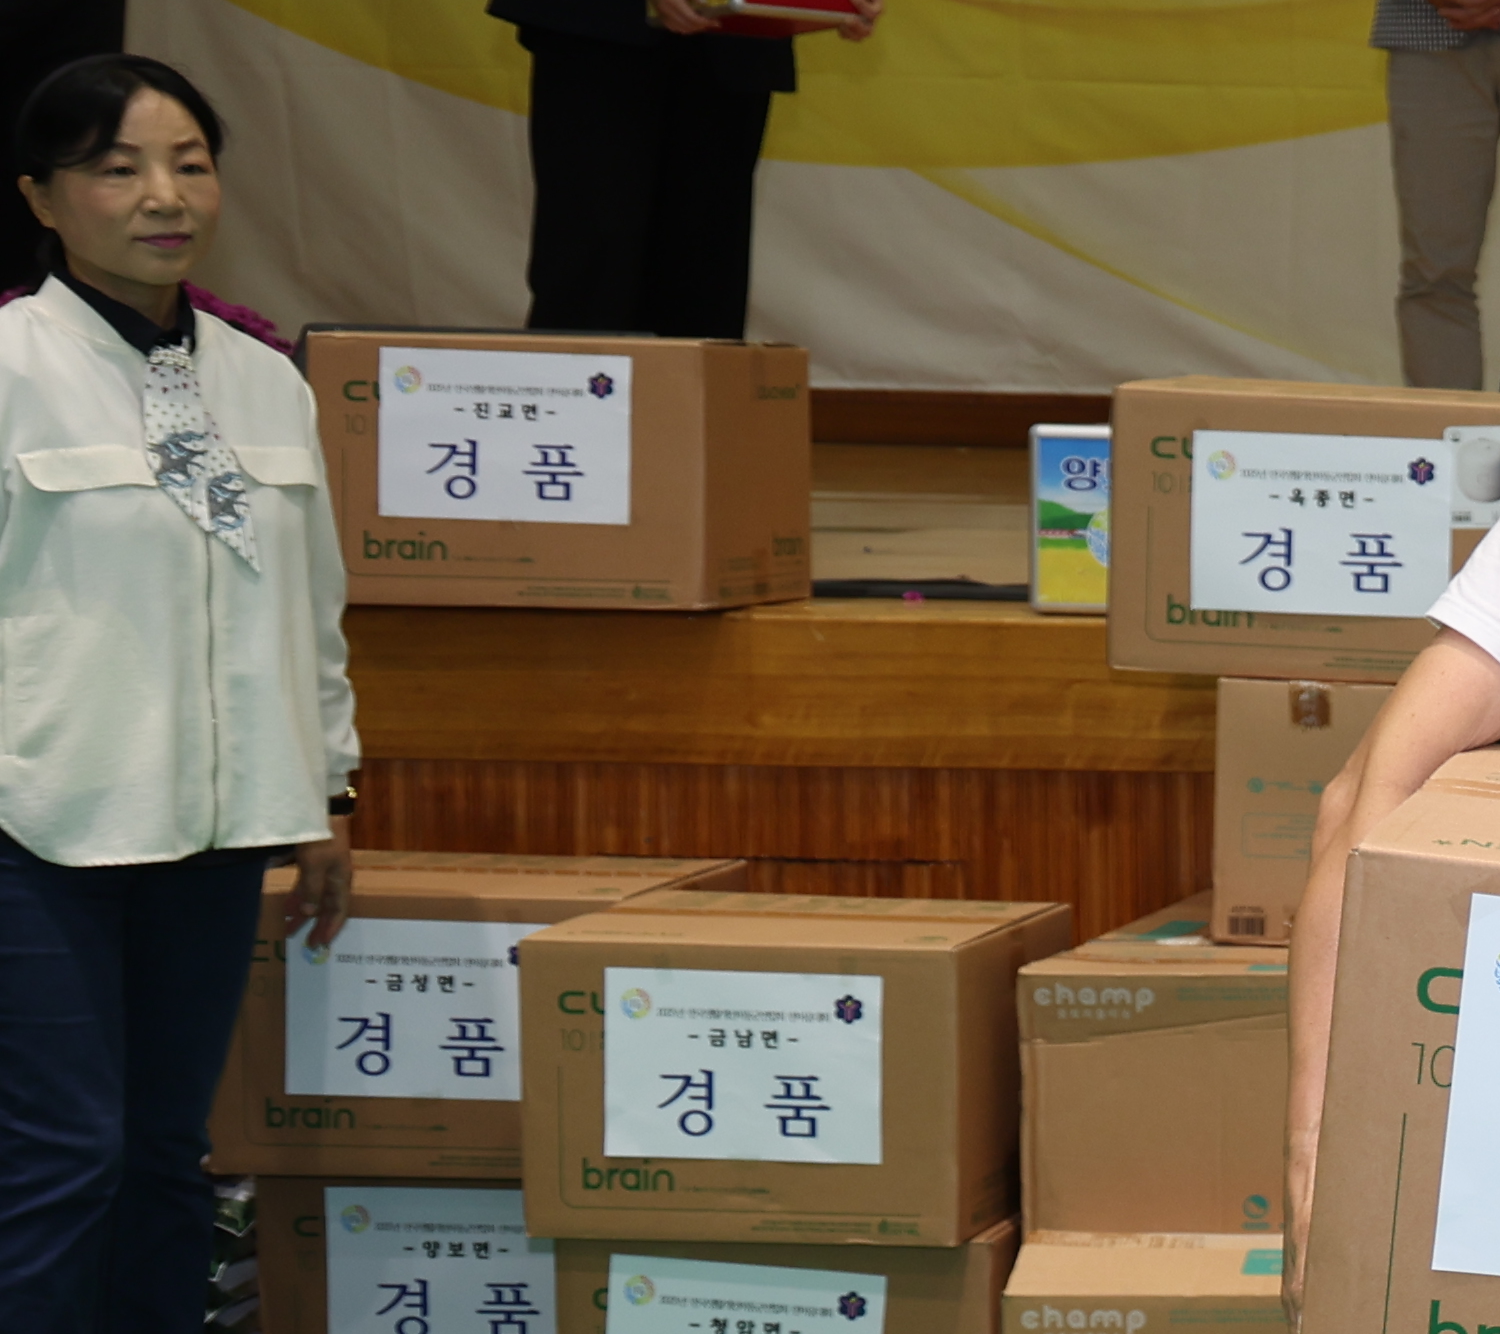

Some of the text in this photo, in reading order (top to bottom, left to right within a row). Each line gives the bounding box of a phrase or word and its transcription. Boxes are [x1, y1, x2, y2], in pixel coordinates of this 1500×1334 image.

[426, 438, 585, 501] 경 품
[363, 530, 449, 561] brain
[1239, 527, 1403, 594] 경 품
[1033, 982, 1155, 1013] champ
[336, 1012, 504, 1077] 경 품
[265, 1097, 356, 1130] brain
[657, 1069, 832, 1139] 경 품
[582, 1158, 675, 1193] brain
